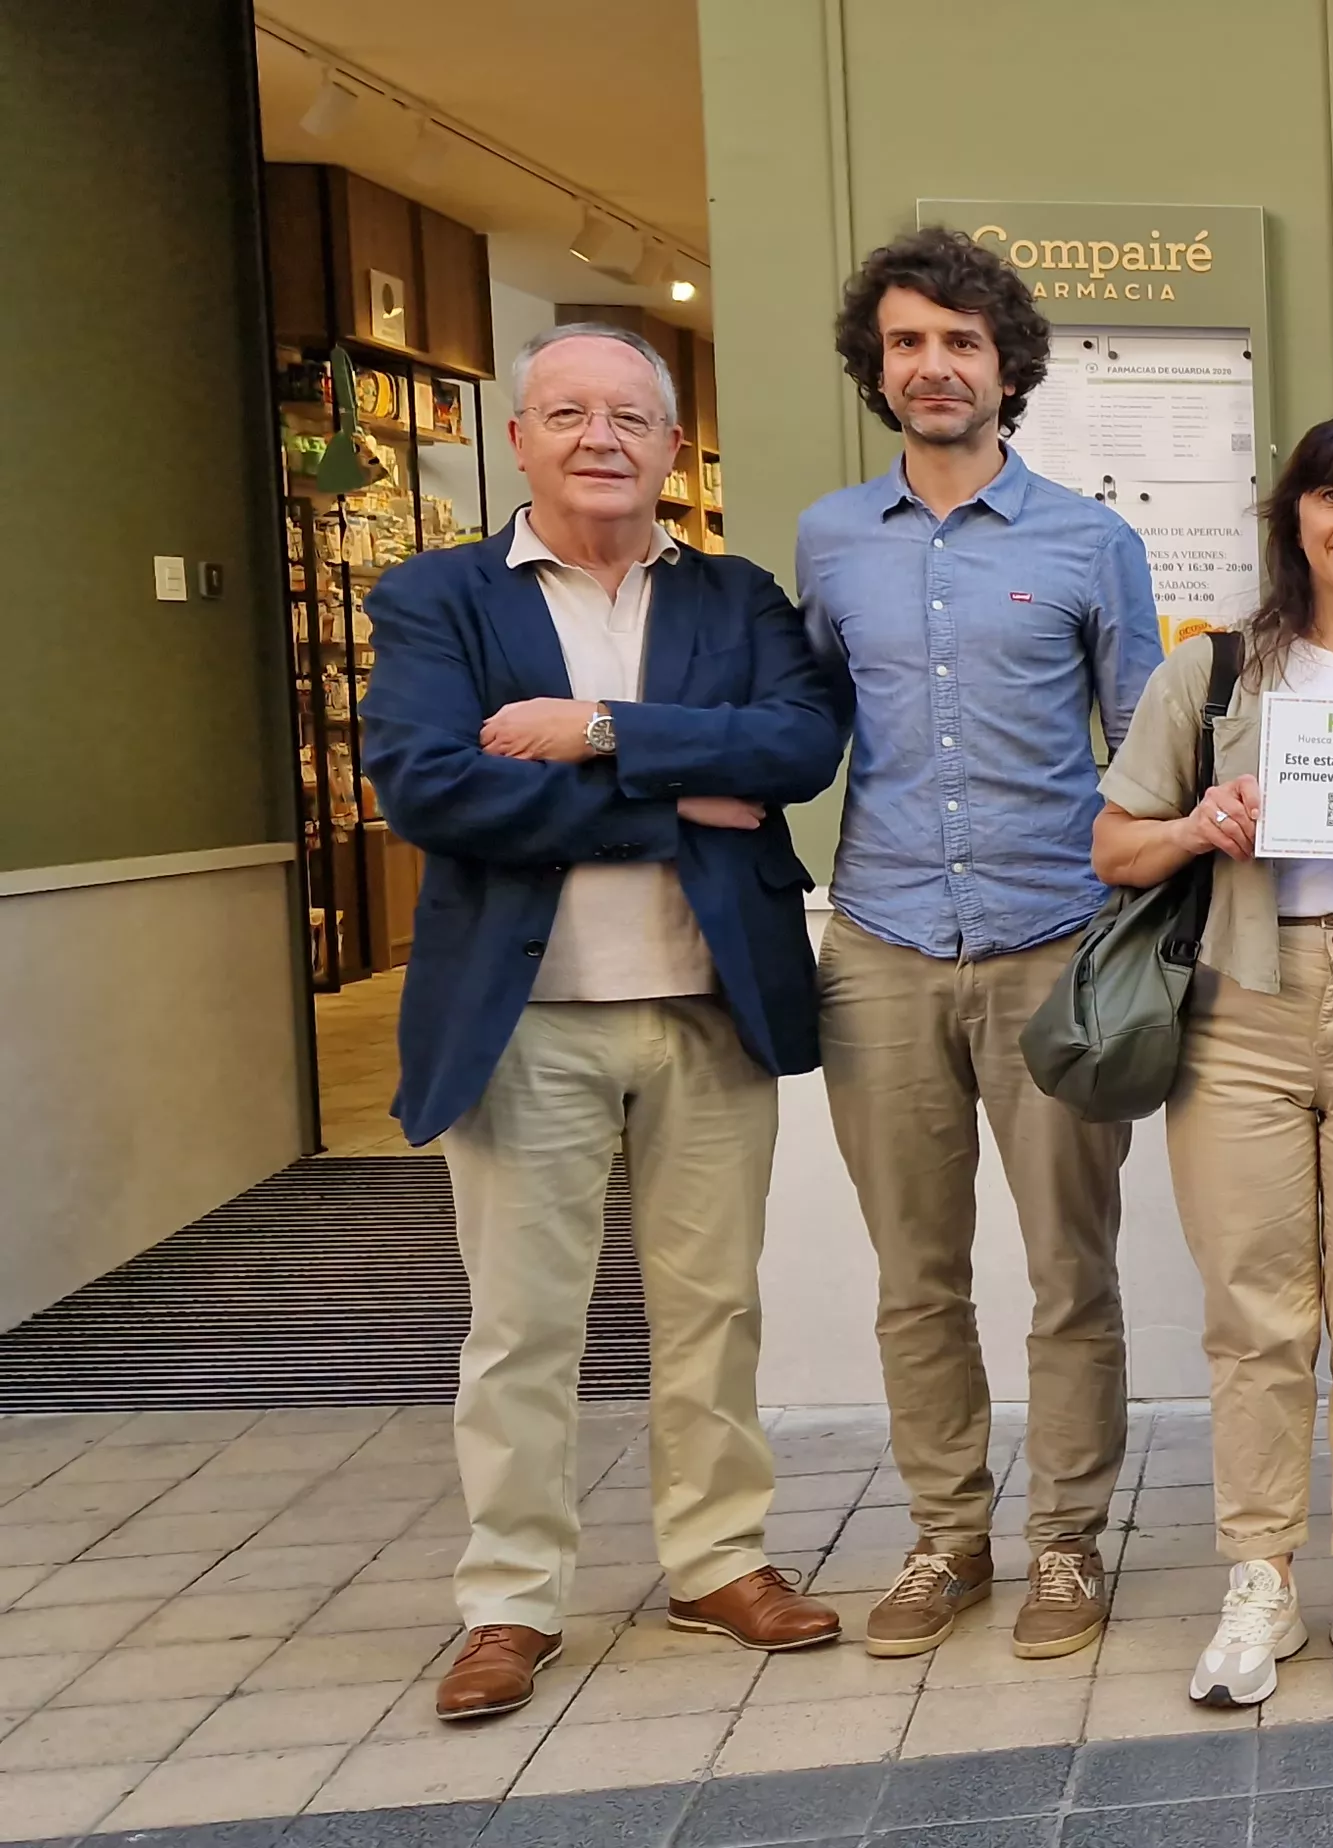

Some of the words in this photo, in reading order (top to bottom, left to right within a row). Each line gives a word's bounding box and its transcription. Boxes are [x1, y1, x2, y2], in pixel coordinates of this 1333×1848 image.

[1033, 282, 1175, 300] ARMACIA
[1171, 367, 1210, 375] GUARDIA
[1136, 528, 1168, 536] RARIO
[1171, 528, 1184, 536] DE
[1186, 528, 1242, 536] APERTURA:
[1172, 551, 1180, 559] A
[1181, 551, 1227, 559] VIERNES:
[1176, 563, 1184, 571] Y
[1188, 563, 1214, 571] 16:30
[1226, 563, 1253, 572] 20:00
[1158, 580, 1209, 589] SÁBADOS:
[1188, 593, 1214, 601] 14:00
[1298, 734, 1332, 744] Huesca
[1285, 753, 1309, 765] Este
